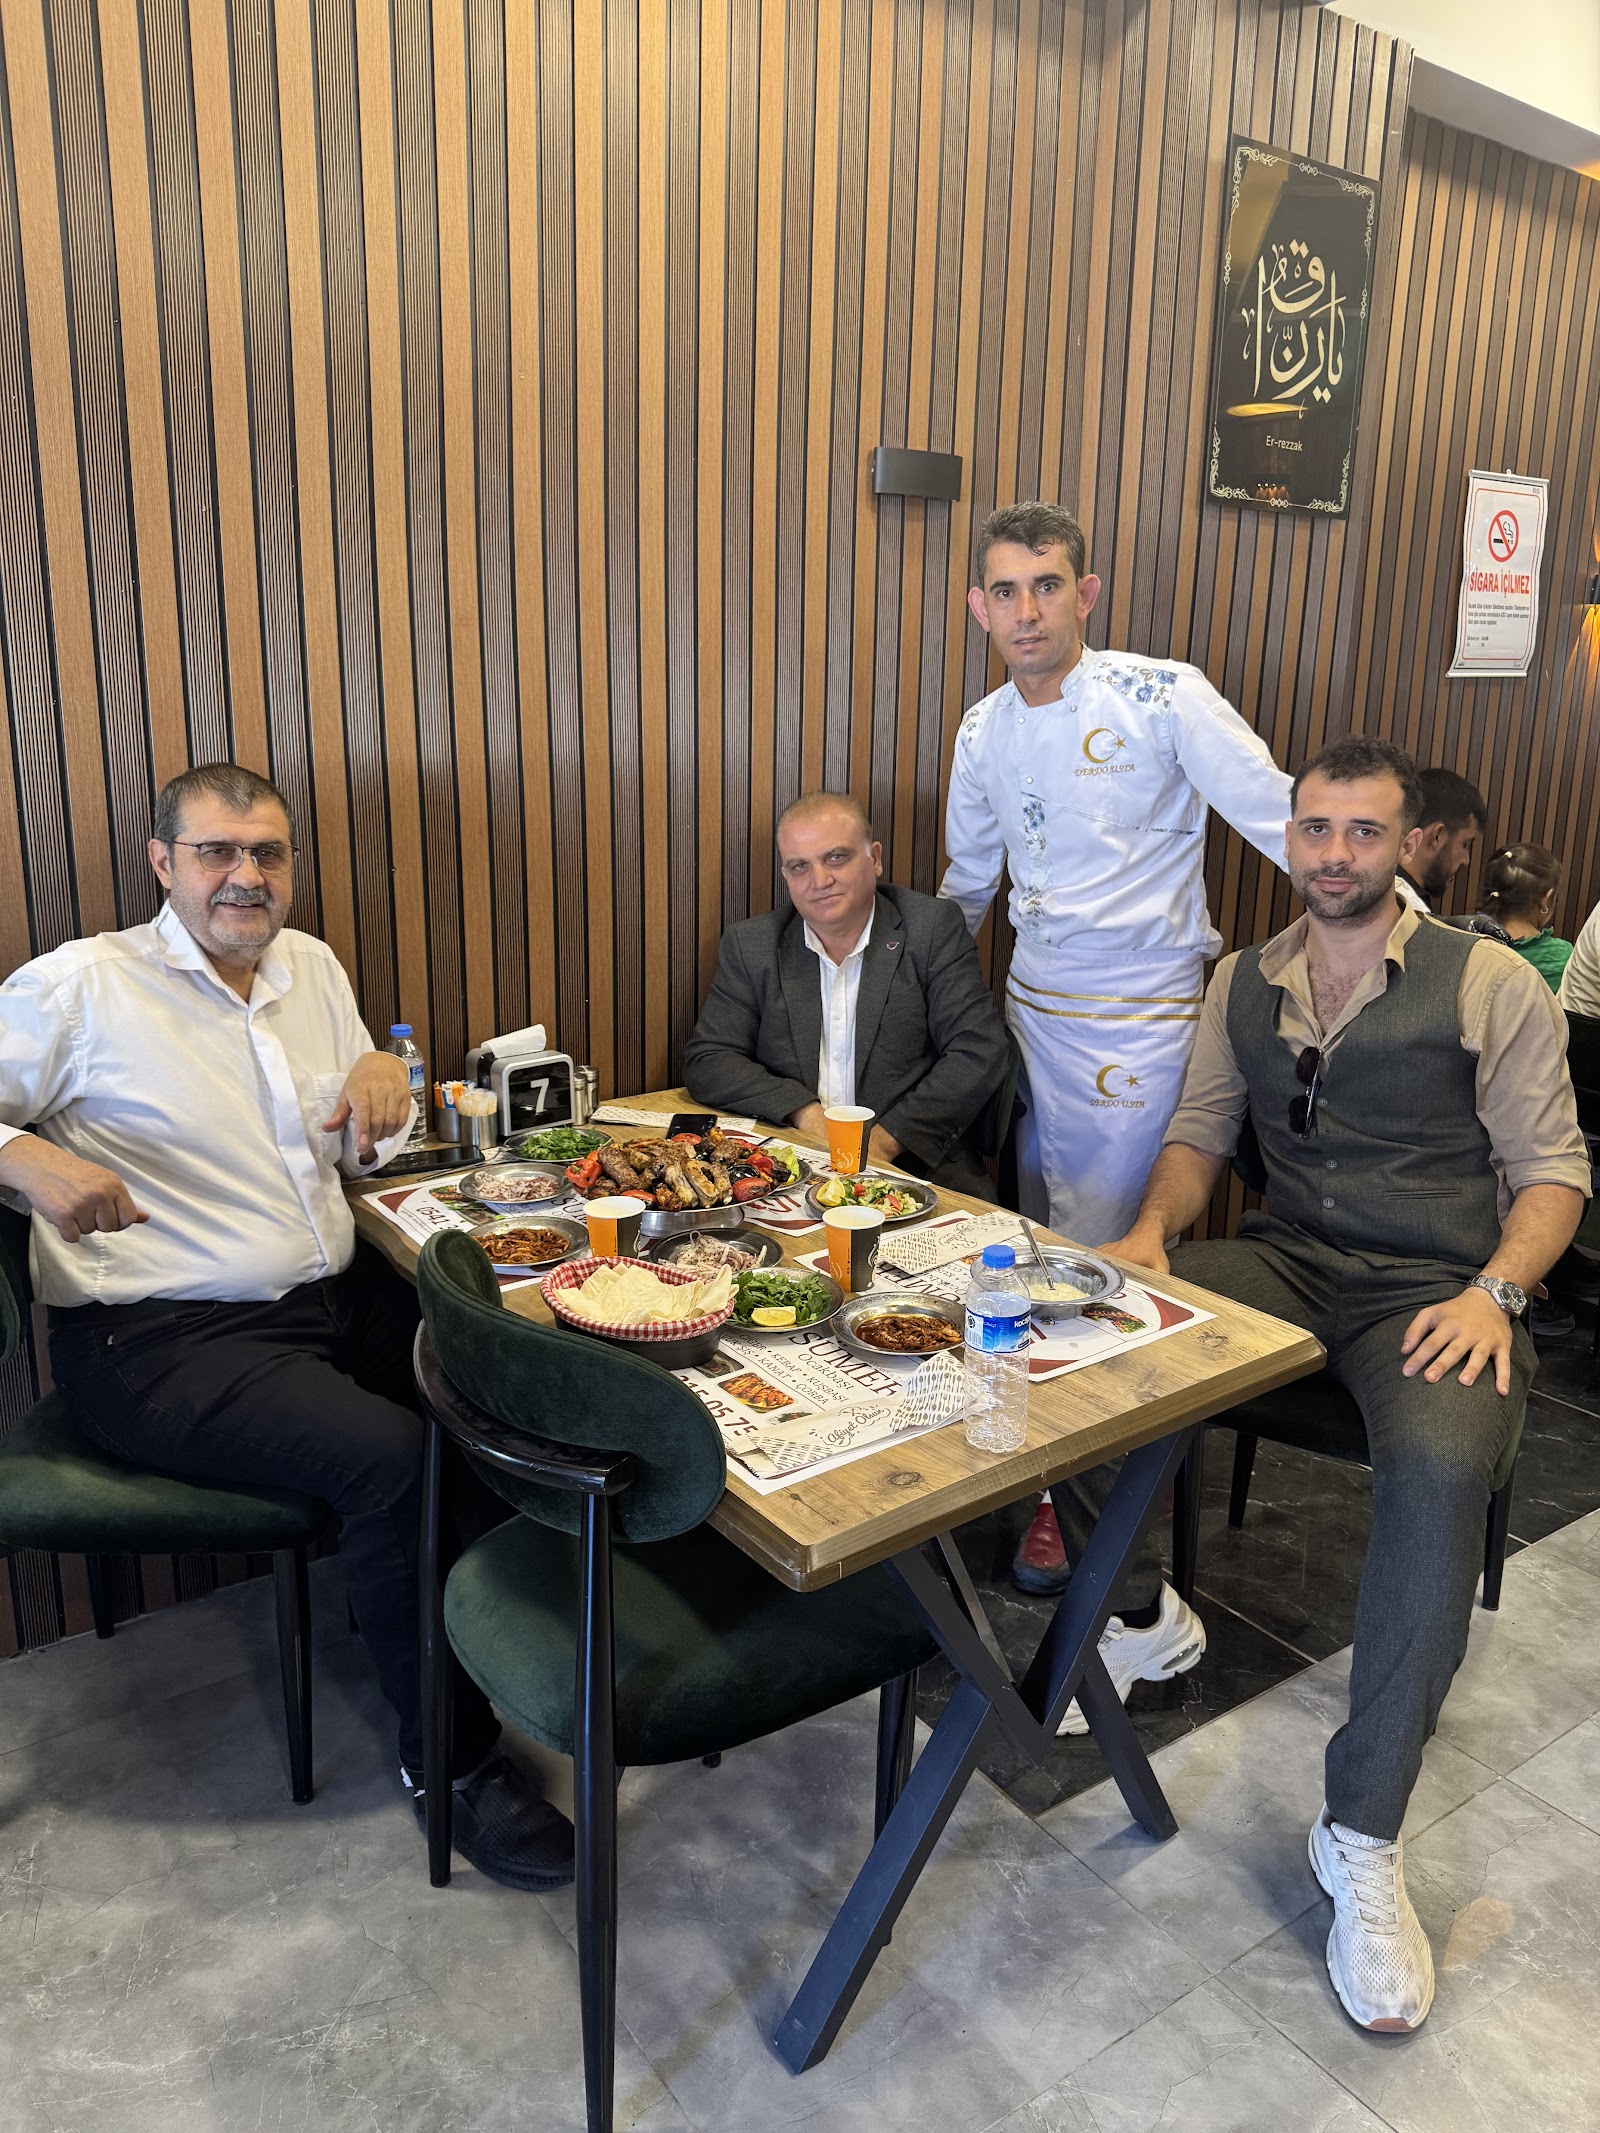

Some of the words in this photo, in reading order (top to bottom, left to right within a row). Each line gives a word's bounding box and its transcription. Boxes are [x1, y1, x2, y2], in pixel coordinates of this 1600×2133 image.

[1265, 435, 1303, 452] Er-rezzak
[1469, 567, 1499, 593] SİGARA
[1500, 569, 1530, 598] İÇİLMEZ
[530, 1077, 550, 1114] 7
[1090, 1098, 1120, 1108] DERDO
[758, 1357, 792, 1379] KANAT
[796, 1382, 828, 1405] ÇORBA
[797, 1353, 854, 1390] Ocakbaşı
